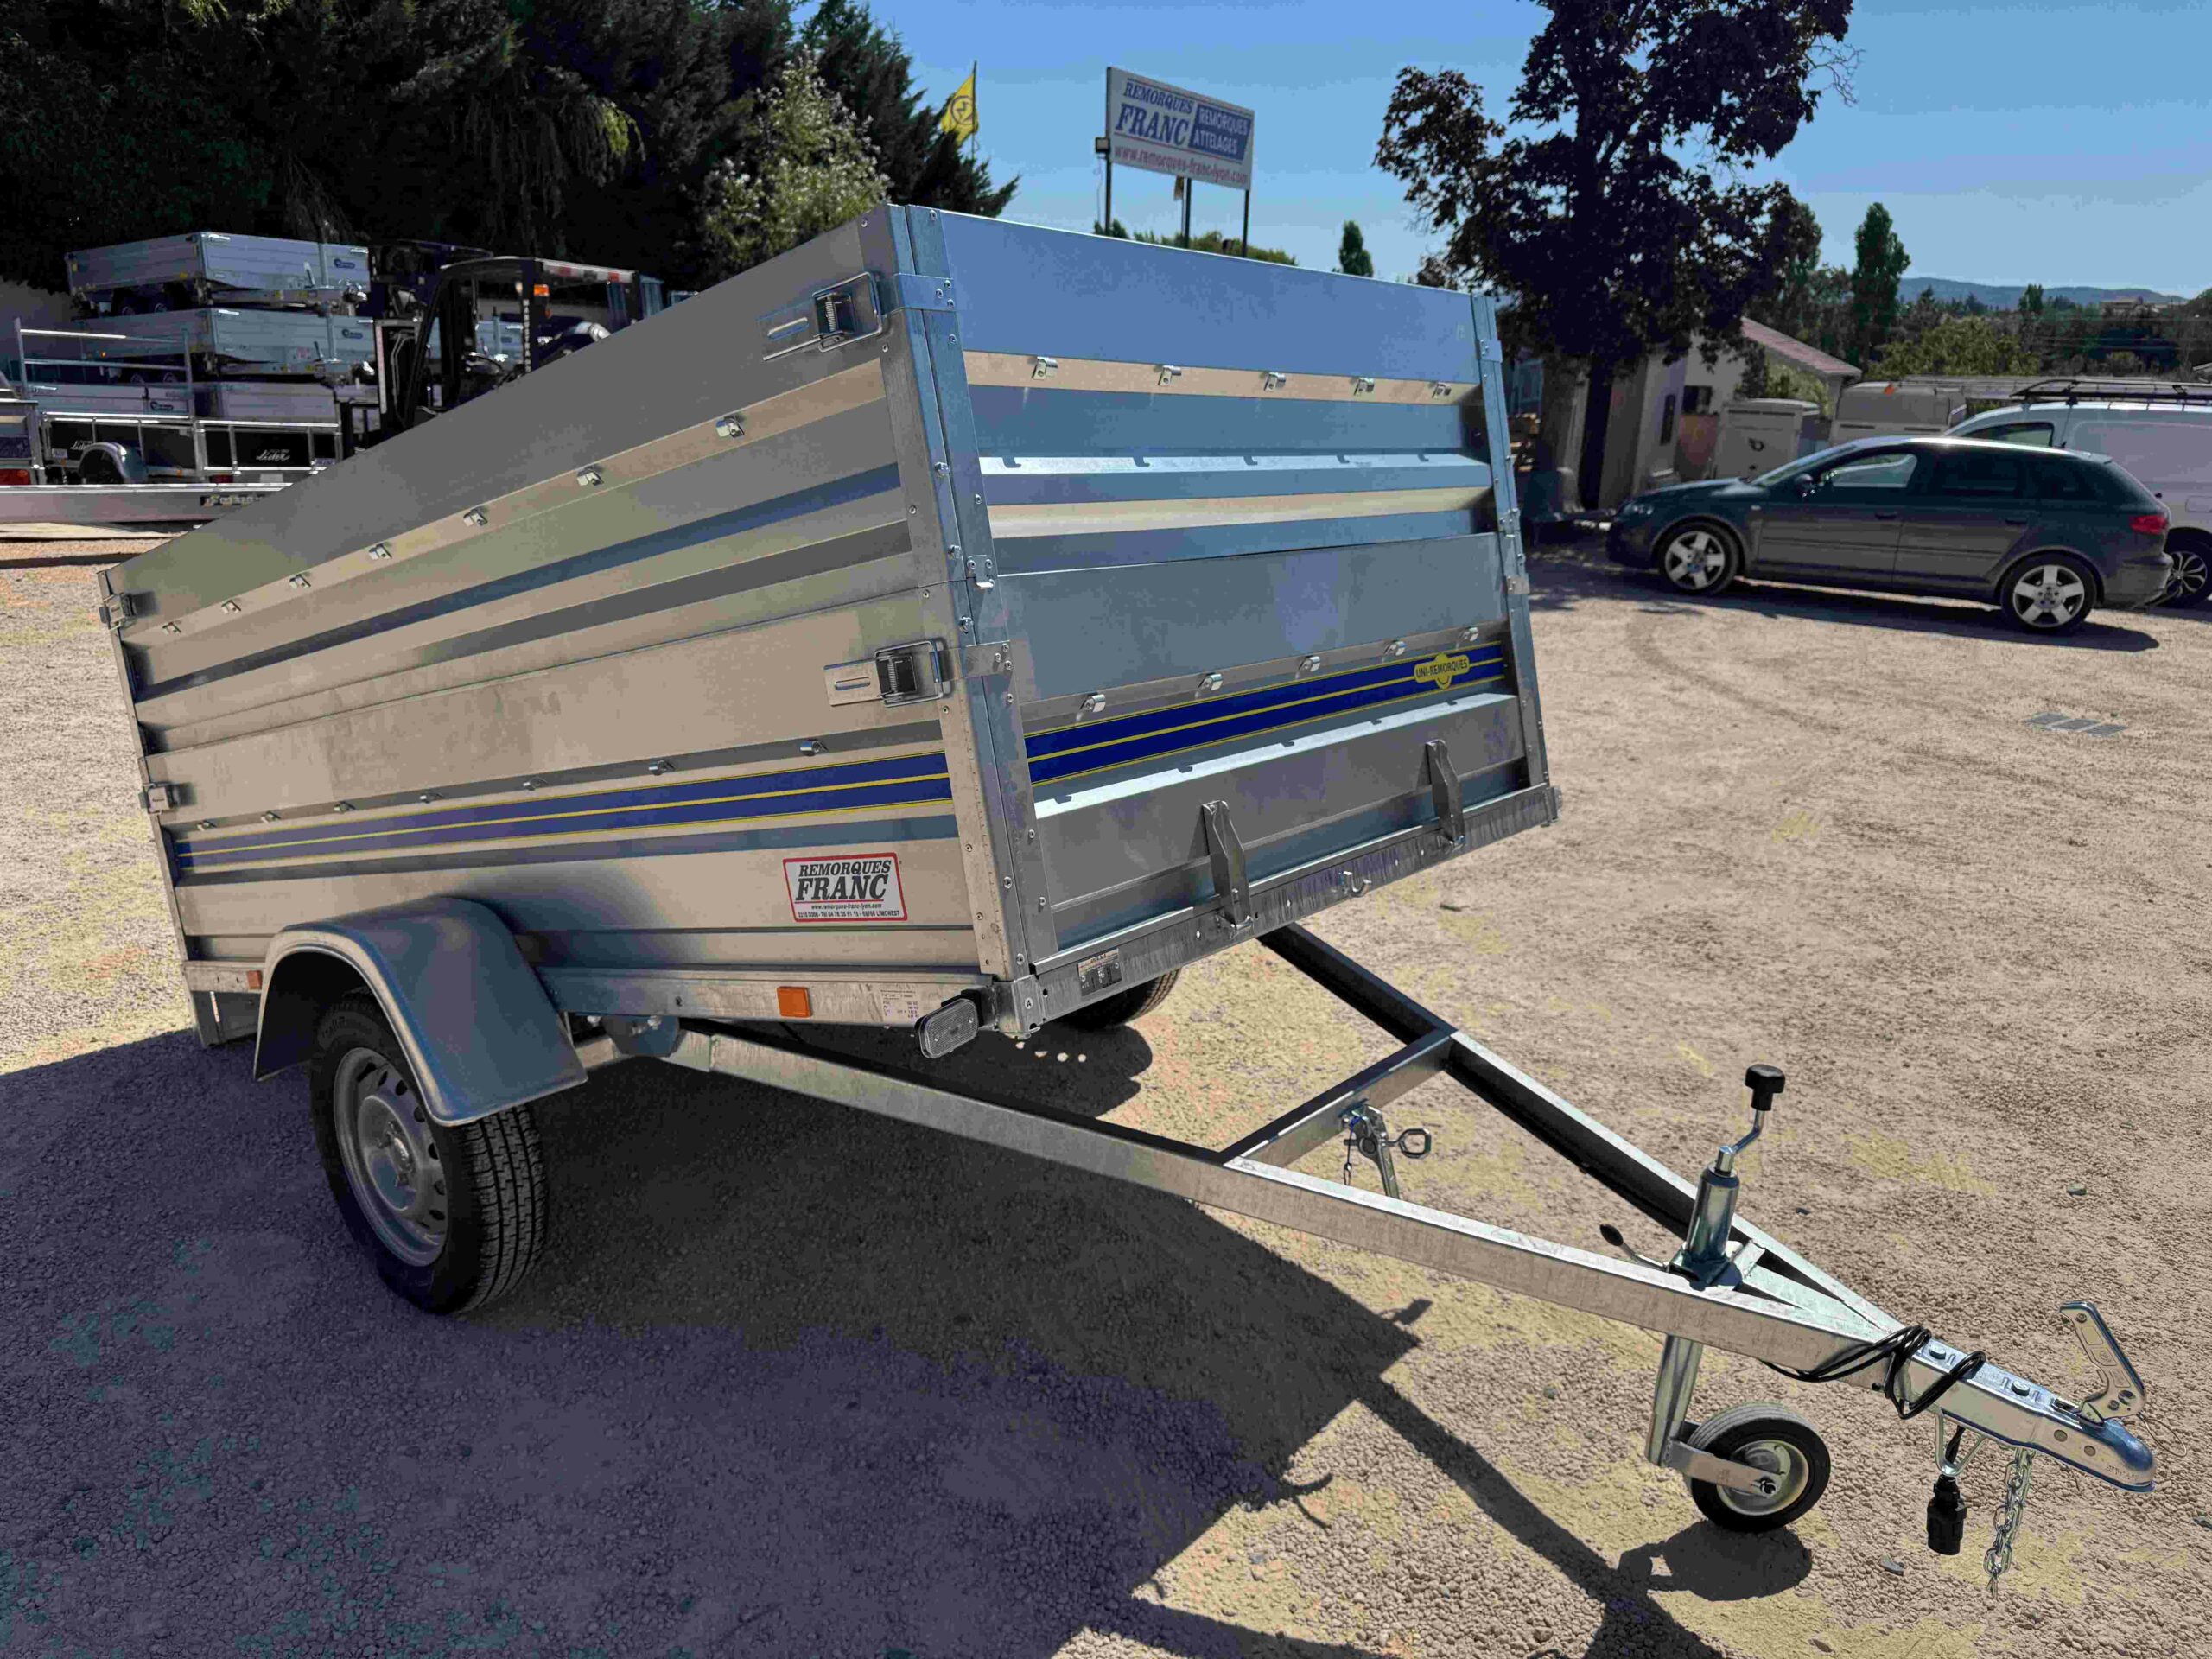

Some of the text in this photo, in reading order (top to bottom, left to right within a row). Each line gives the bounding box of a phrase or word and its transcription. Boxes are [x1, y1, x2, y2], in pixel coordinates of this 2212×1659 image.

[1123, 82, 1193, 114] REMORQUES
[1115, 104, 1189, 146] FRANC
[1198, 109, 1248, 136] REMORQUES
[1193, 130, 1237, 154] ATTELAGES
[1417, 658, 1467, 678] UNI-REMORQUES
[798, 860, 891, 877] REMORQUES
[796, 874, 888, 900] FRANC
